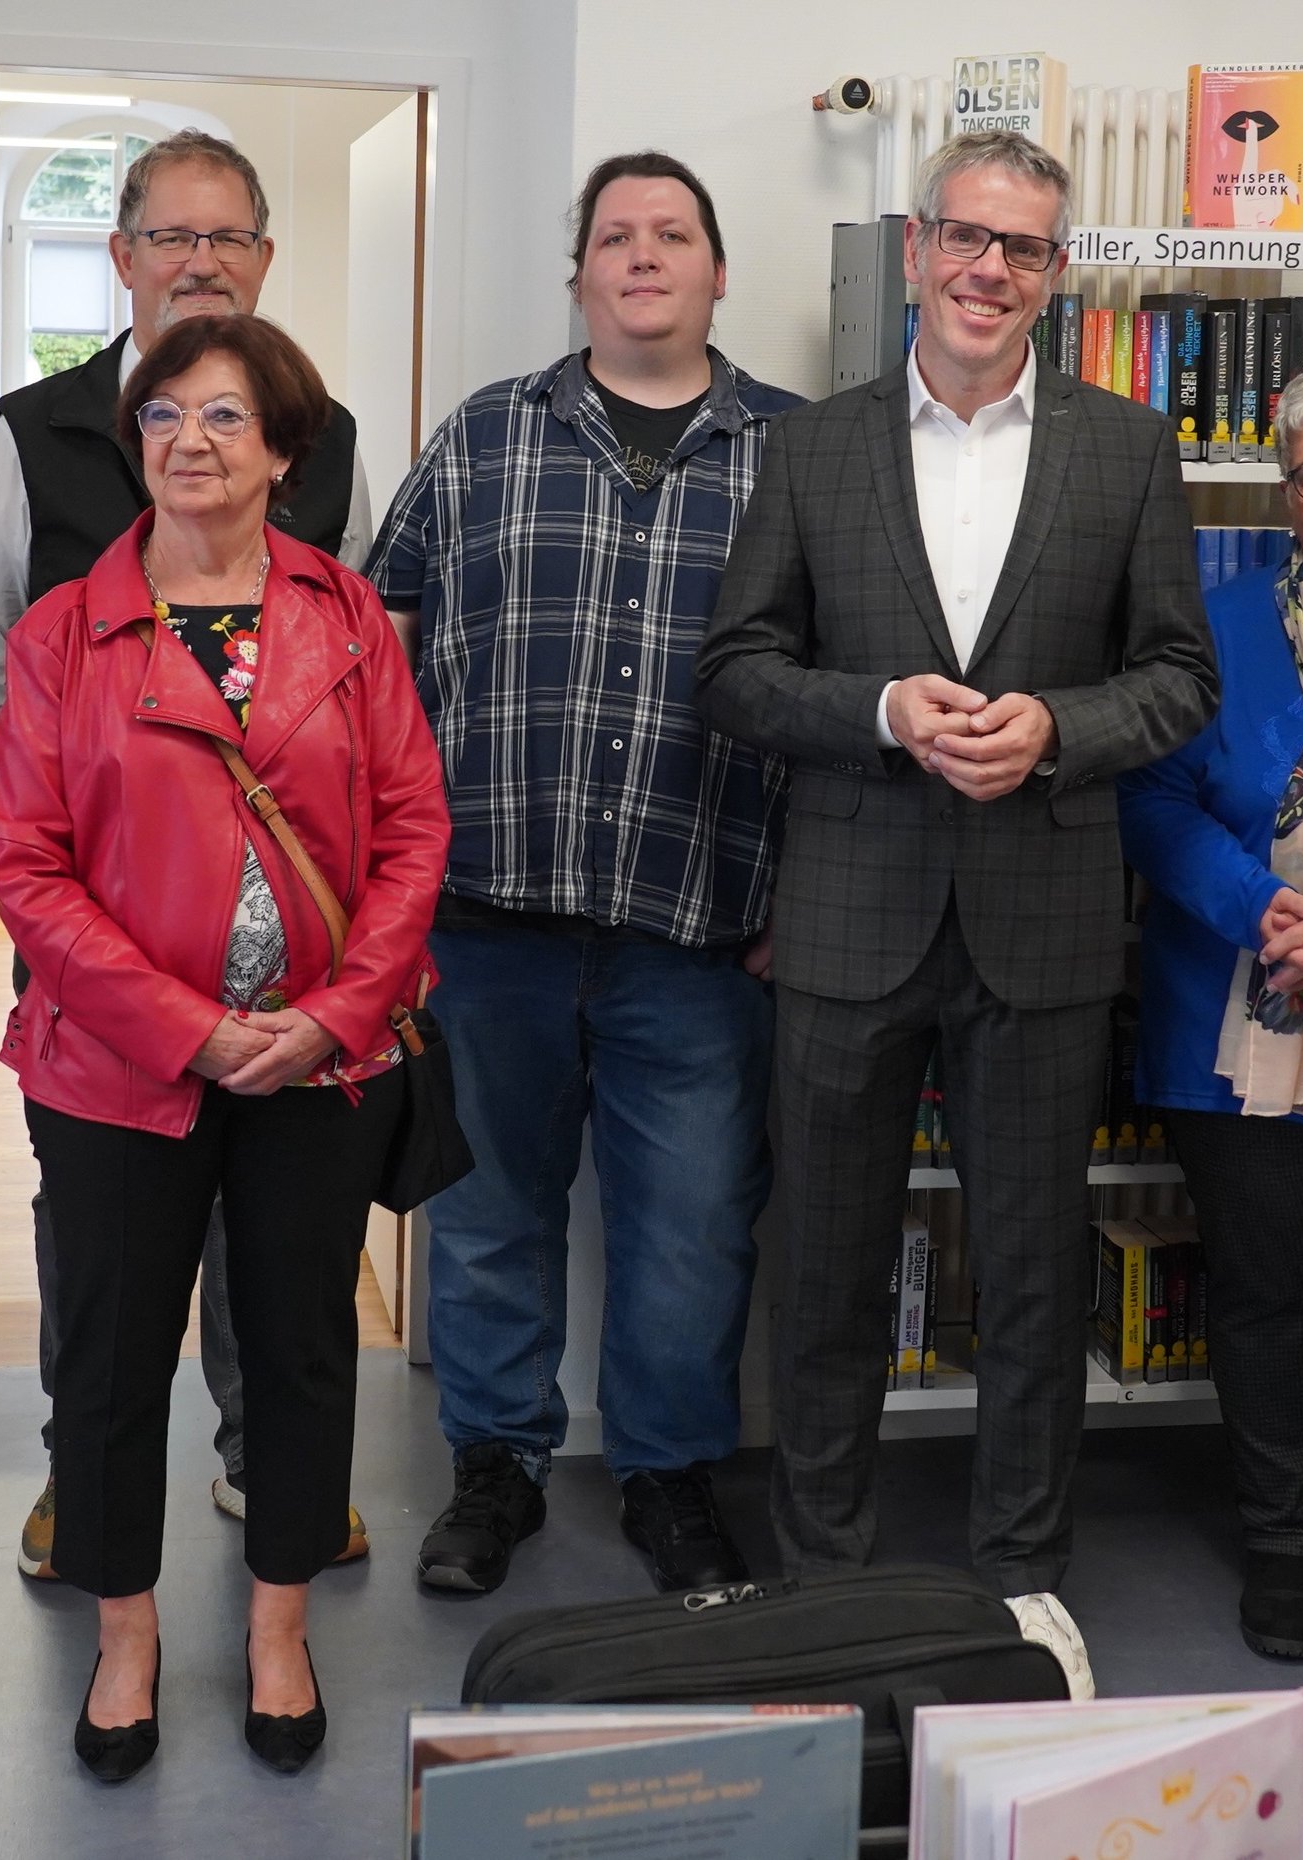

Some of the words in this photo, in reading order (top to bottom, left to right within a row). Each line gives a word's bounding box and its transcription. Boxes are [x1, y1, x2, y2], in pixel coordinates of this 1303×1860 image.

[958, 58, 1041, 87] ADLER
[1206, 64, 1263, 73] CHANDLER
[955, 83, 1040, 114] OLSEN
[961, 115, 1030, 134] TAKEOVER
[1213, 186, 1289, 196] NETWORK
[1217, 173, 1286, 184] WHISPER
[1155, 233, 1301, 268] Spannung
[1185, 309, 1194, 367] WASHINGTON
[1193, 320, 1201, 357] DEKRET
[1243, 311, 1255, 385] SCHÄNDUNG
[1219, 331, 1228, 389] ERBARMEN
[1269, 332, 1282, 388] ERLÖSUNG
[1181, 372, 1189, 405] ADLER
[1188, 371, 1197, 405] OLSEN
[905, 1245, 915, 1286] Wolfgang
[913, 1237, 927, 1292] BURGER
[906, 1308, 914, 1330] ENDE
[912, 1303, 920, 1330] ZORNS
[906, 1331, 913, 1344] AM
[911, 1330, 919, 1346] DES
[1125, 1391, 1134, 1401] C
